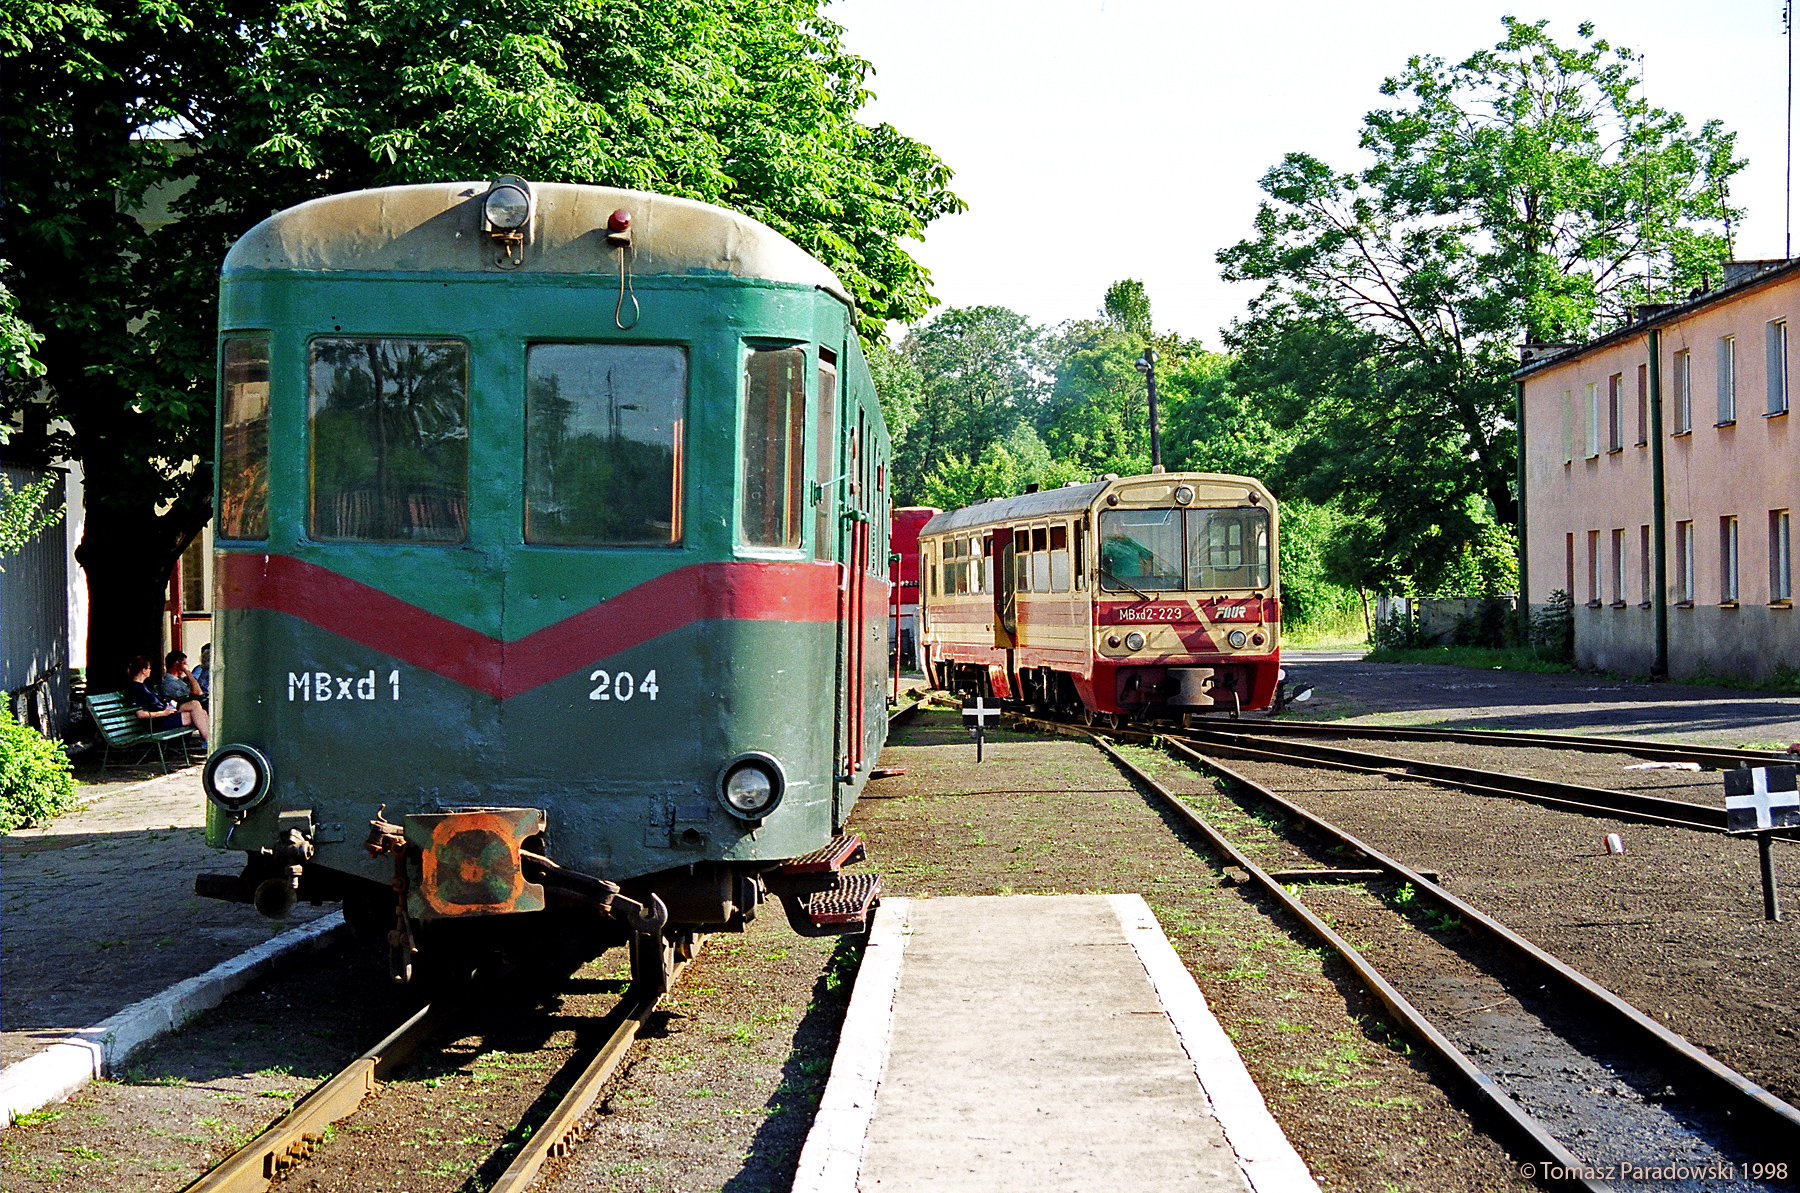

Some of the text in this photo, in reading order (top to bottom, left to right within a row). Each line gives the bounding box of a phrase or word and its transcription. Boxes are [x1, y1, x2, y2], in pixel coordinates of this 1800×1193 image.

[1119, 608, 1182, 621] MBxd2-229
[288, 669, 400, 702] MBxd 1
[589, 669, 660, 702] 204
